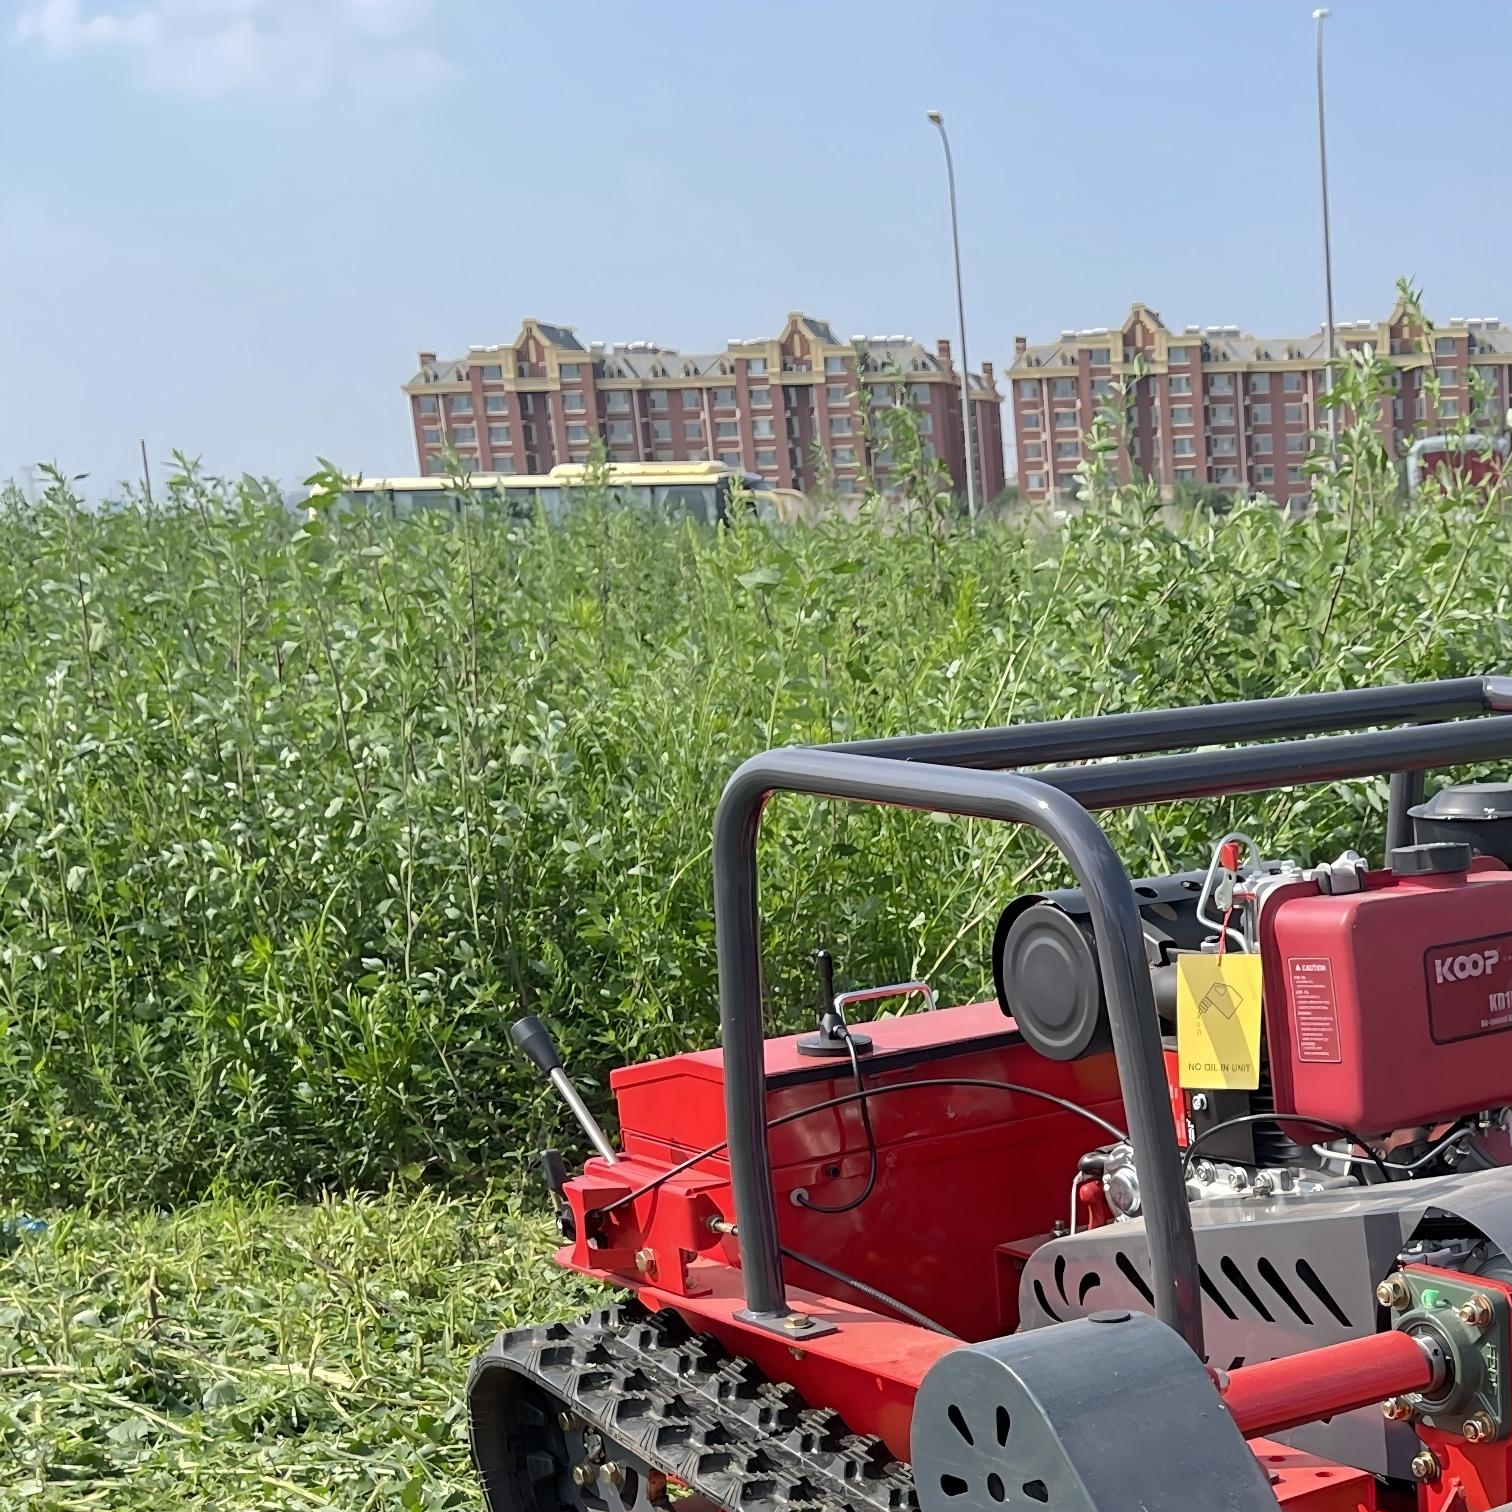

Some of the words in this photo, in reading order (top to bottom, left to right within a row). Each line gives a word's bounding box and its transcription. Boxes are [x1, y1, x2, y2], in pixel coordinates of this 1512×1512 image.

[1434, 949, 1499, 984] KOOP
[1188, 1063, 1201, 1071] NO
[1204, 1063, 1218, 1071] OIL
[1220, 1063, 1229, 1072] IN
[1231, 1063, 1251, 1072] UNIT
